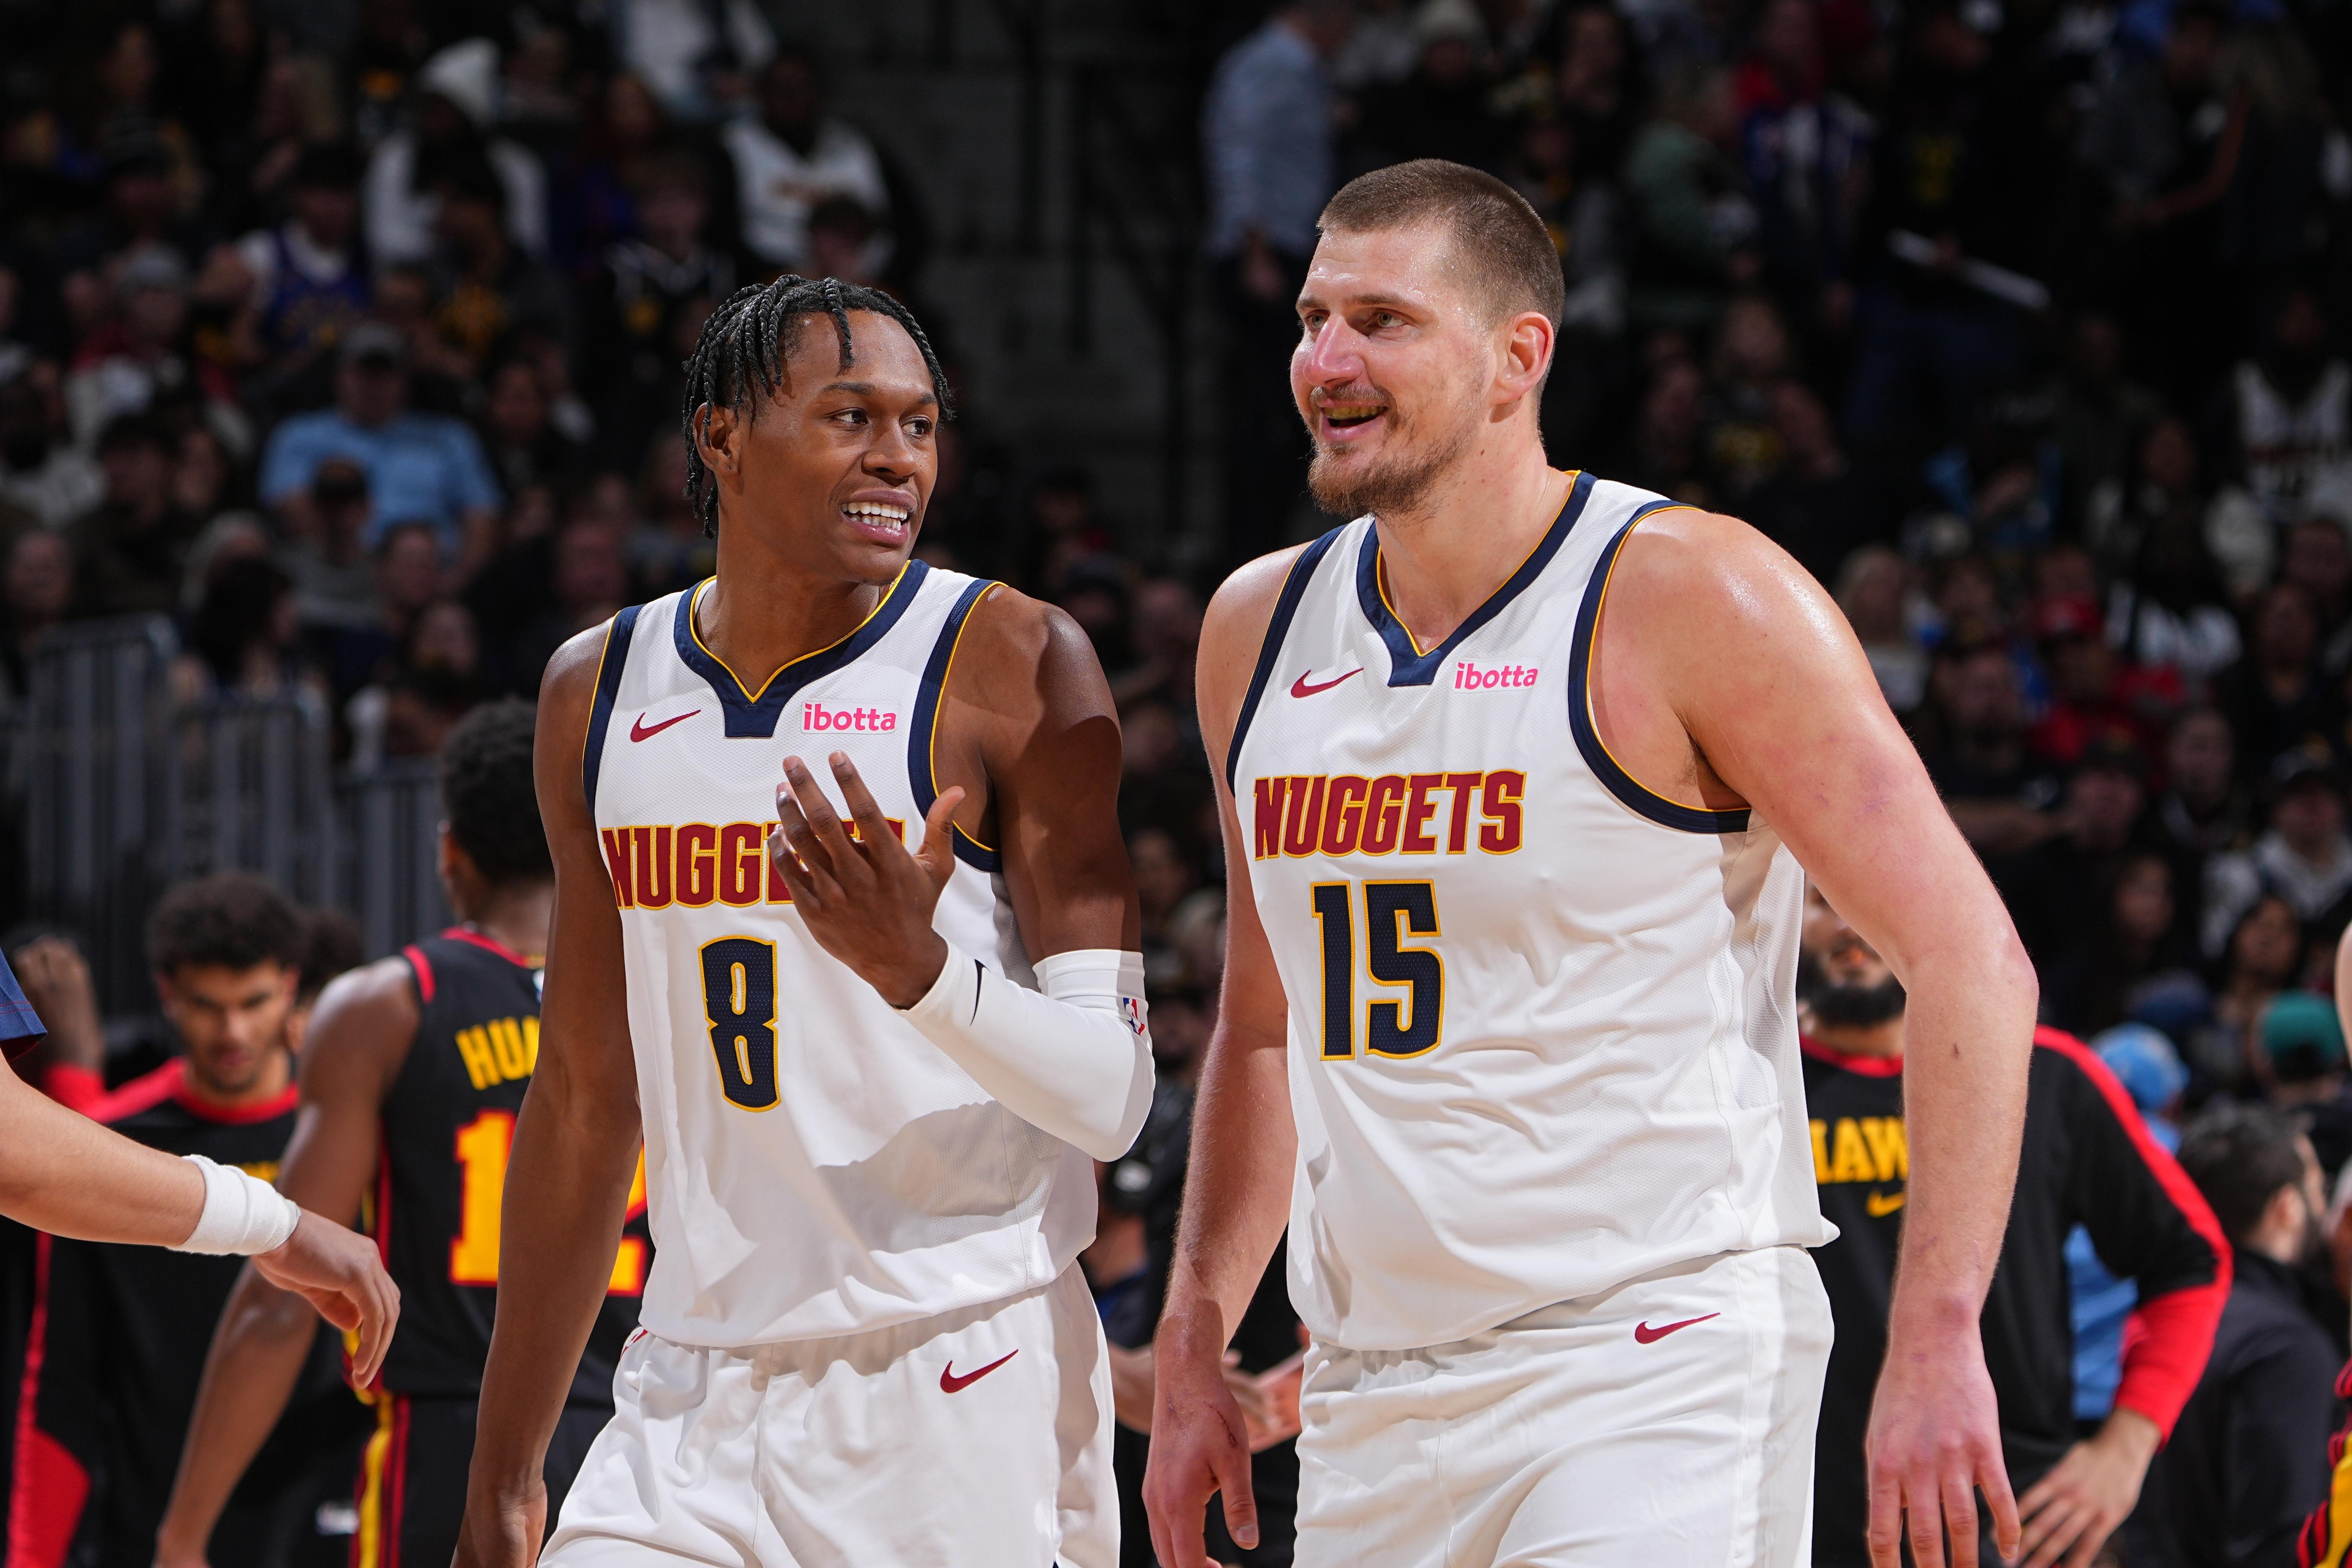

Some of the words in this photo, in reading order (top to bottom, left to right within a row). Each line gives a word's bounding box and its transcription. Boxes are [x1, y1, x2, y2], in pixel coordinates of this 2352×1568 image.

[804, 703, 896, 731] ibotta
[1455, 662, 1538, 690] ibotta
[1254, 769, 1527, 861] NUGGETS
[1310, 879, 1445, 1061] 15
[698, 934, 781, 1113] 8
